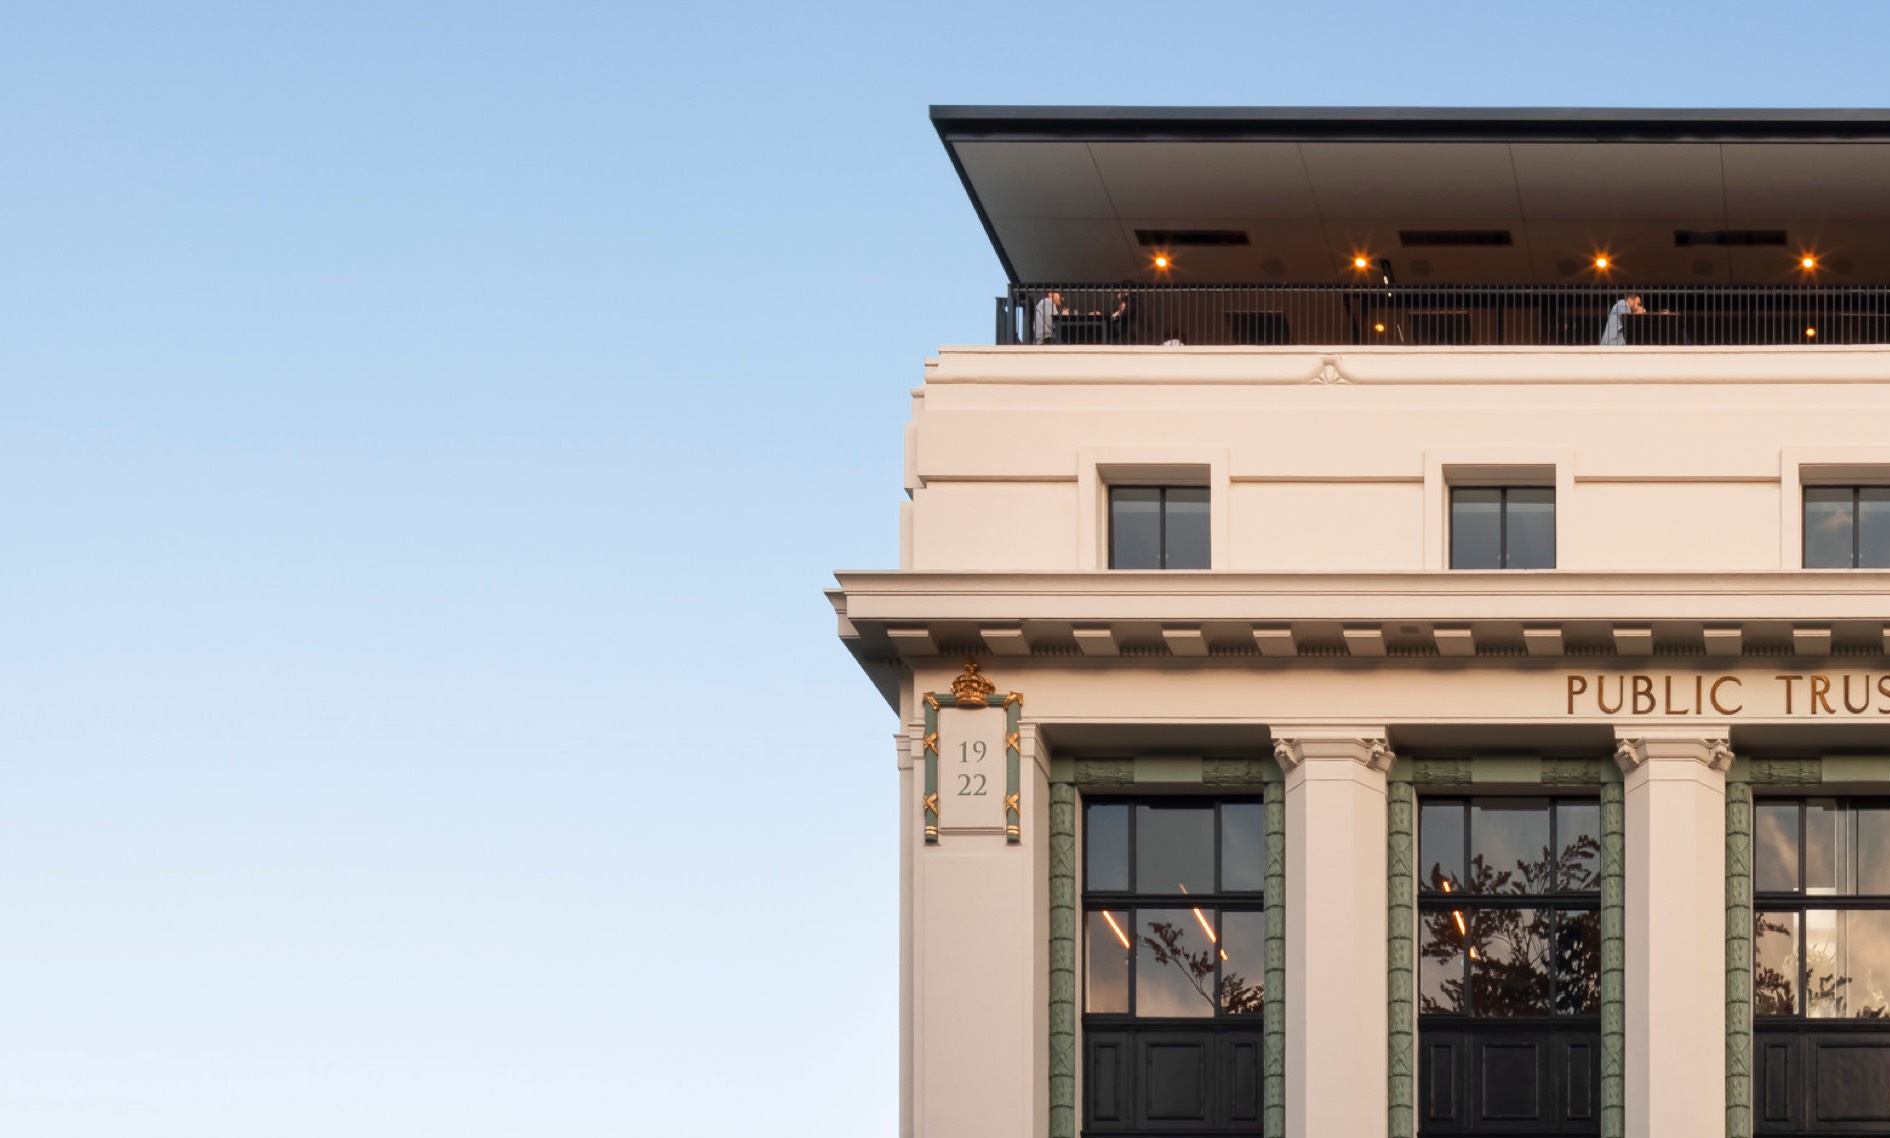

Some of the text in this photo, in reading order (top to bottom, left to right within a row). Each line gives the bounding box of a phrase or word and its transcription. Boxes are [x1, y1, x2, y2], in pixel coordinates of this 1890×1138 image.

[1565, 674, 1743, 716] PUBLIC
[958, 740, 988, 764] 19
[957, 773, 988, 797] 22
